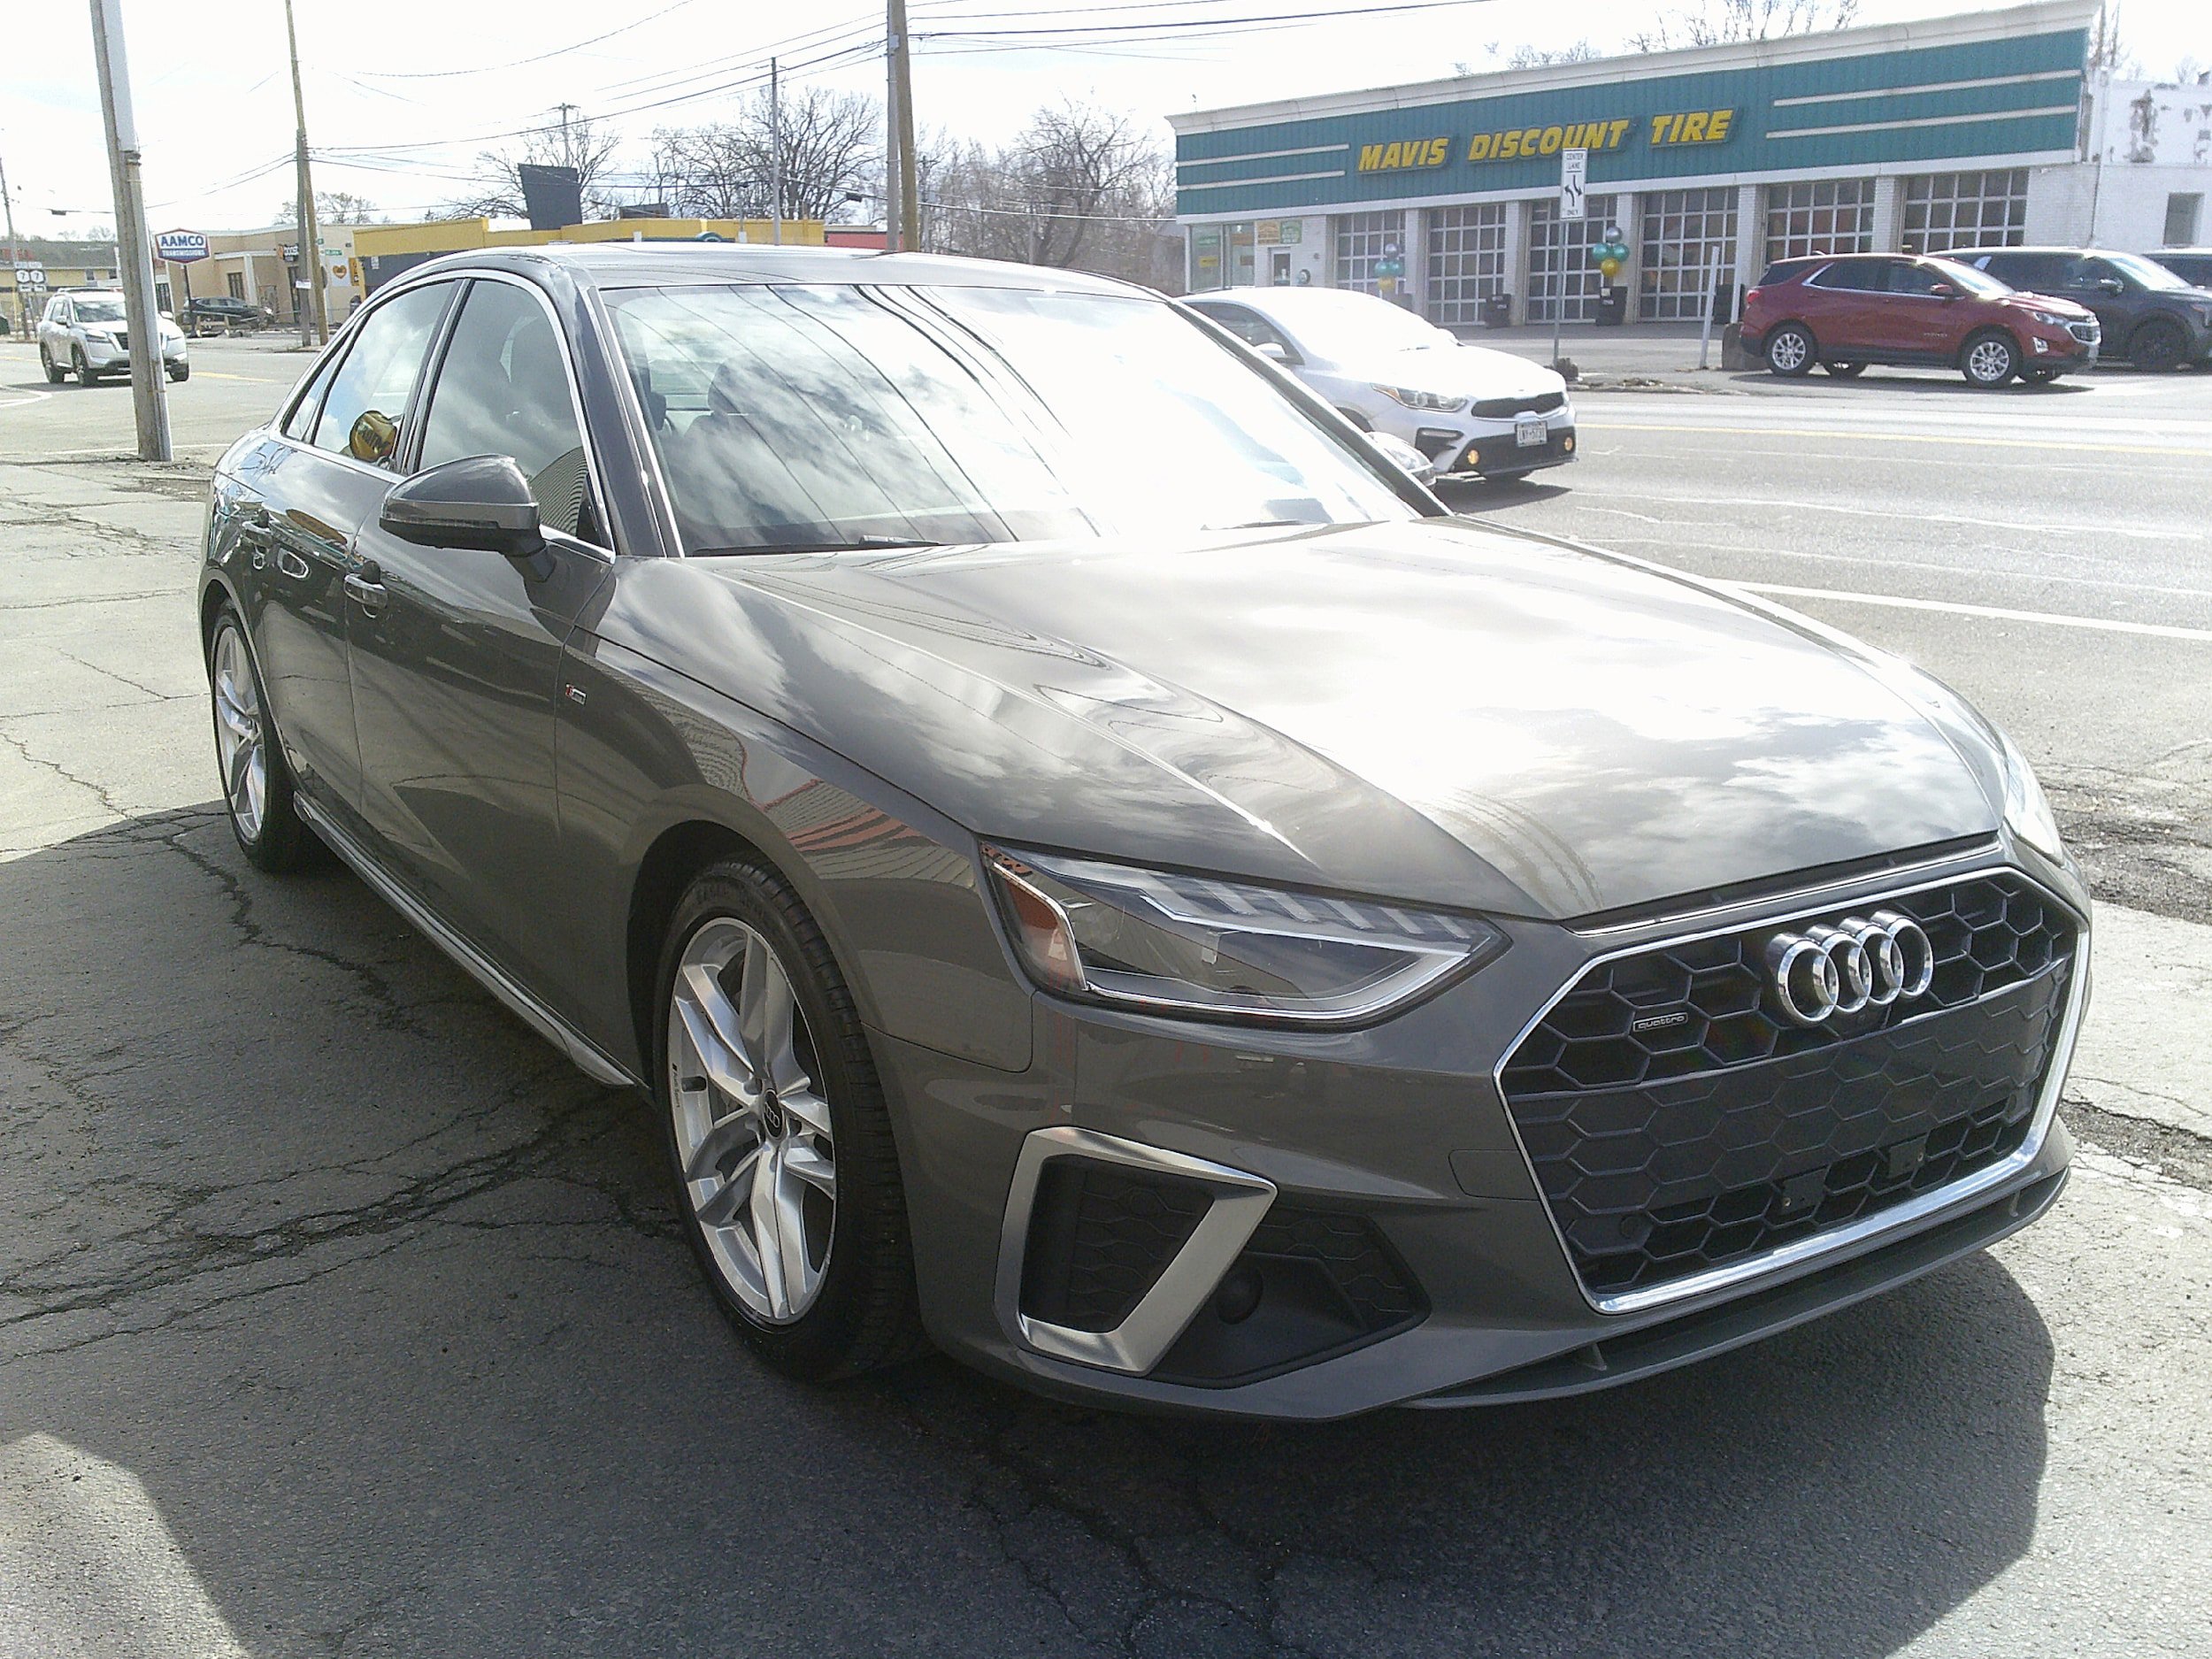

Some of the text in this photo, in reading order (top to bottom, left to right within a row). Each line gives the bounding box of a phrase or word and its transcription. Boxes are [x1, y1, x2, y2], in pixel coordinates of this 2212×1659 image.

[1358, 109, 1734, 172] MAVIS DISCOUNT TIRE
[160, 234, 204, 247] AAMCO
[1638, 1015, 1685, 1030] quattro
